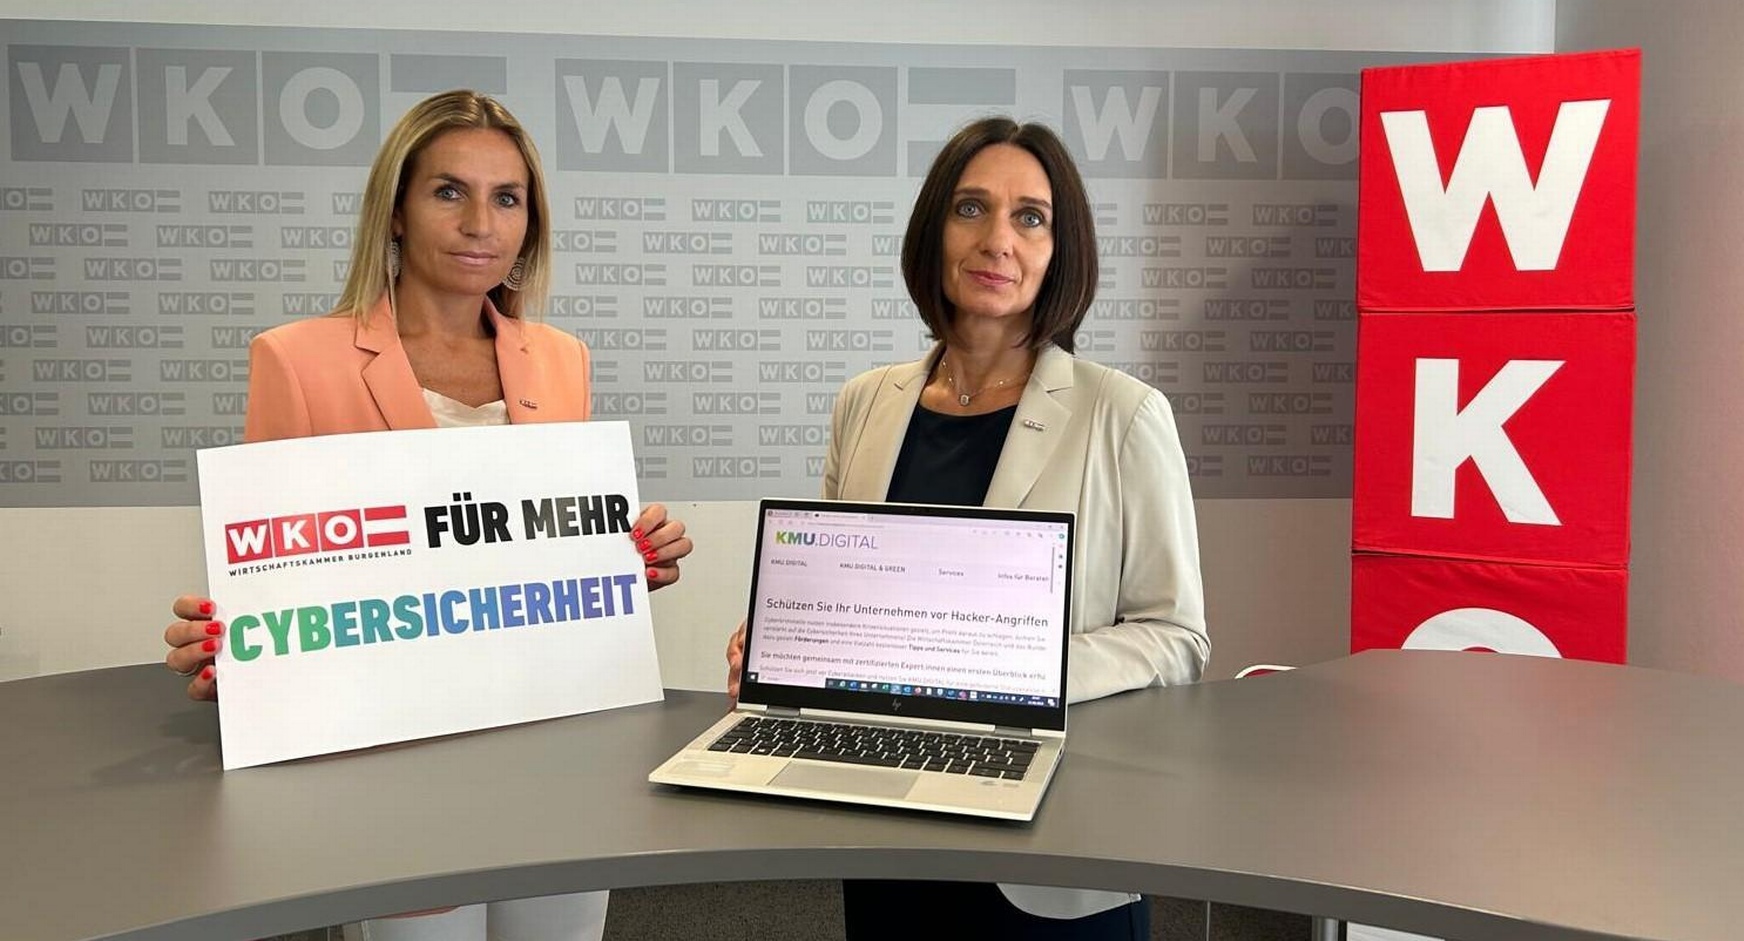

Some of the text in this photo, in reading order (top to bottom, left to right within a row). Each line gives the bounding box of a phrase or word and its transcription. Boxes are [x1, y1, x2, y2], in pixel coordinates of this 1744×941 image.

[17, 61, 365, 151] WKO
[564, 75, 884, 162] WKO
[1069, 85, 1360, 165] WKO
[84, 191, 153, 210] WKO
[210, 193, 278, 212] WKO
[576, 199, 641, 218] WKO
[694, 201, 756, 220] WKO
[808, 203, 870, 221] WKO
[1145, 206, 1204, 224] WKO
[1255, 206, 1313, 224] WKO
[31, 225, 101, 245] WKO
[158, 227, 227, 246] WKO
[283, 228, 350, 247] WKO
[644, 234, 708, 252] WKO
[761, 235, 822, 253] WKO
[1207, 238, 1266, 255] WKO
[86, 260, 156, 279] WKO
[212, 261, 280, 280] WKO
[577, 266, 641, 283] WKO
[694, 267, 757, 284] WKO
[808, 268, 869, 286] WKO
[1144, 269, 1203, 287] WKO
[1254, 270, 1312, 287] WKO
[33, 293, 103, 312] WKO
[160, 294, 228, 313] WKO
[645, 298, 708, 317] WKO
[761, 300, 822, 317] WKO
[1096, 301, 1155, 318] WKO
[1206, 301, 1265, 319] WKO
[88, 328, 157, 347] WKO
[694, 331, 756, 348] WKO
[808, 332, 869, 349] WKO
[1142, 333, 1202, 349] WKO
[1253, 333, 1311, 349] WKO
[35, 361, 104, 380] WKO
[162, 362, 229, 379] WKO
[645, 362, 708, 380] WKO
[761, 363, 822, 380] WKO
[1205, 364, 1264, 381] WKO
[89, 394, 158, 413] WKO
[694, 395, 756, 413] WKO
[1251, 395, 1310, 412] WKO
[37, 428, 106, 447] WKO
[163, 429, 233, 446] WKO
[645, 427, 708, 445] WKO
[761, 427, 824, 444] WKO
[1204, 426, 1263, 443] WKO
[91, 462, 160, 480] WKO
[694, 459, 757, 476] WKO
[1250, 457, 1309, 474] WKO
[229, 492, 632, 557] WKO FÜR MEHR
[775, 531, 878, 549] KMU.DIGITAL
[228, 548, 412, 577] WIRTSCHAFTSKAMMER BURGENLAND
[939, 568, 964, 577] Services
[229, 574, 637, 662] CYBERSICHERHEIT
[766, 598, 1049, 628] Schützen Sie Ihr Unternehmen vor Hacker-Angriffen
[794, 635, 829, 644] Förderungen
[761, 651, 771, 659] Sie
[773, 652, 801, 661] möchten
[802, 655, 841, 664] gemeinsam
[843, 656, 854, 664] mit
[855, 658, 899, 669] zertifizierten
[968, 667, 991, 676] ersten
